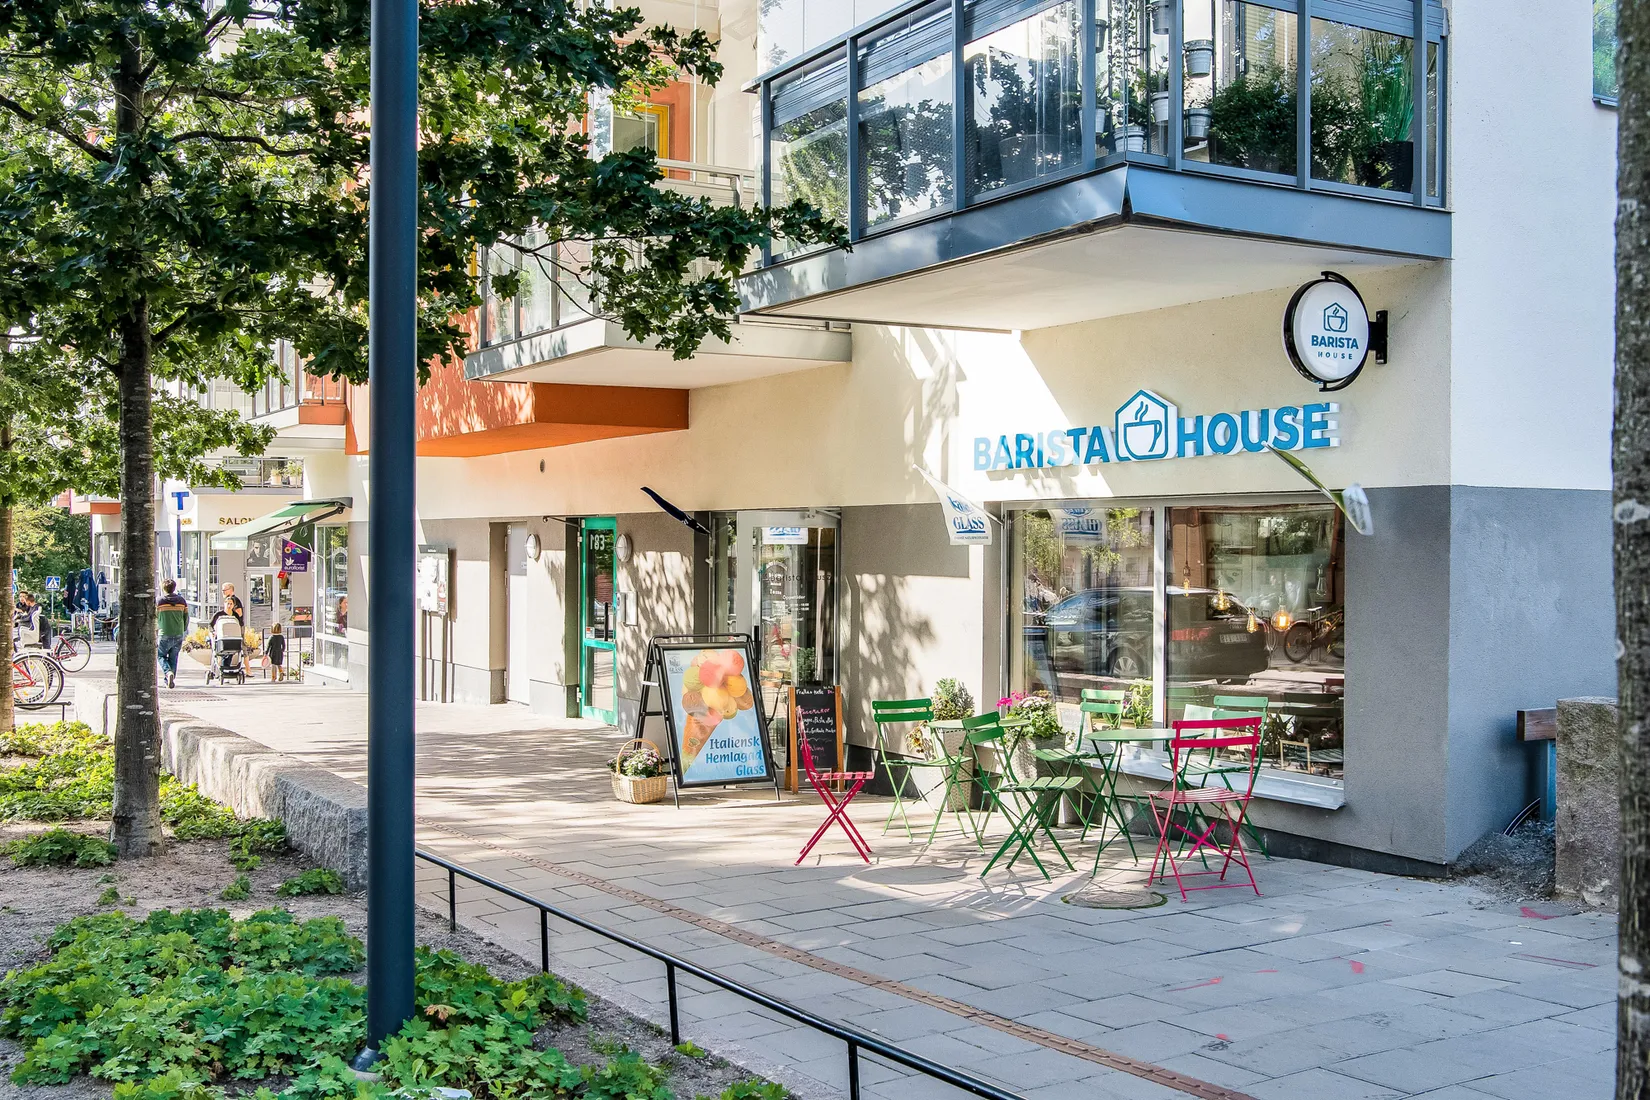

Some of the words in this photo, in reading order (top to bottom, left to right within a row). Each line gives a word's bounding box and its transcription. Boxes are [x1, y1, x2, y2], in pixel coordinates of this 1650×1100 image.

[1311, 335, 1359, 349] BARISTA
[973, 425, 1112, 471] BARISTA
[1177, 402, 1336, 458] HOUSE
[171, 491, 190, 510] T
[953, 516, 985, 530] GLASS
[709, 736, 760, 750] Italiensk
[705, 749, 762, 763] Hemlagad
[735, 764, 764, 776] Glass
